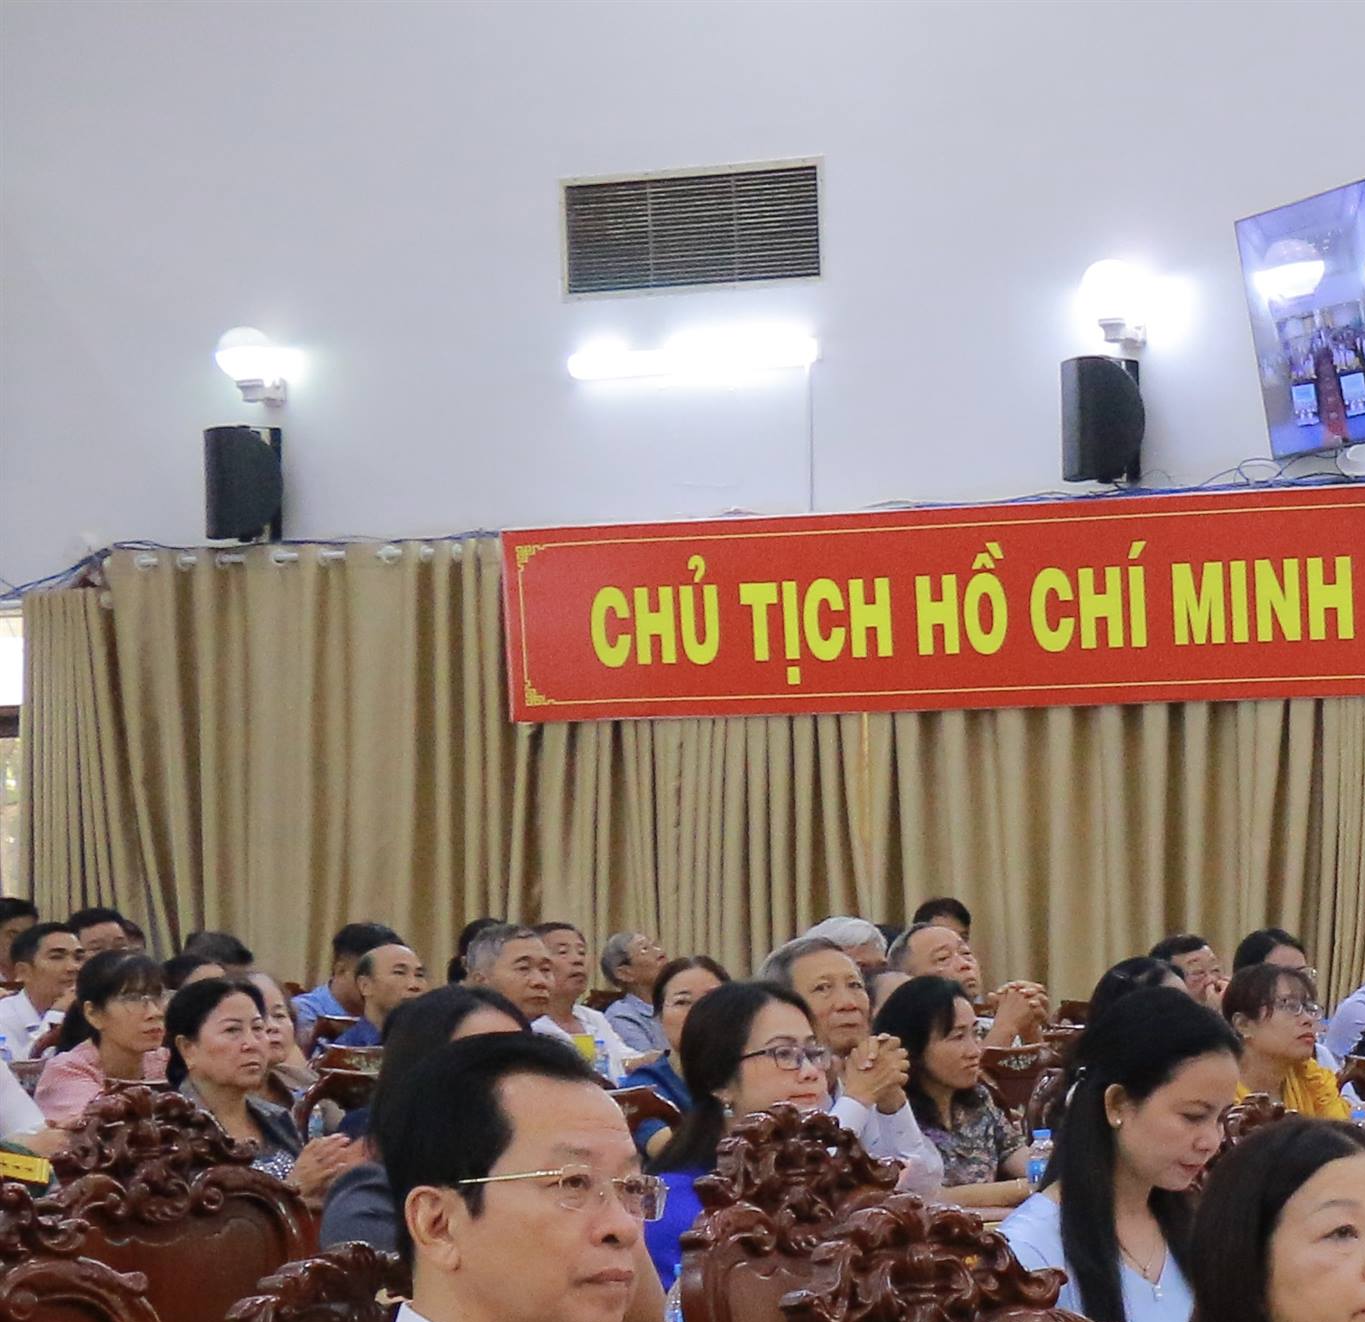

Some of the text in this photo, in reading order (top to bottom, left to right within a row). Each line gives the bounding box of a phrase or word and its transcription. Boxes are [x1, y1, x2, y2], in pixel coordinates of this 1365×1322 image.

[590, 554, 720, 668] CHỦ
[739, 577, 893, 685] TỊCH
[915, 542, 1008, 656] HỒ
[1030, 540, 1147, 652] CHÍ
[1171, 556, 1355, 645] MINH
